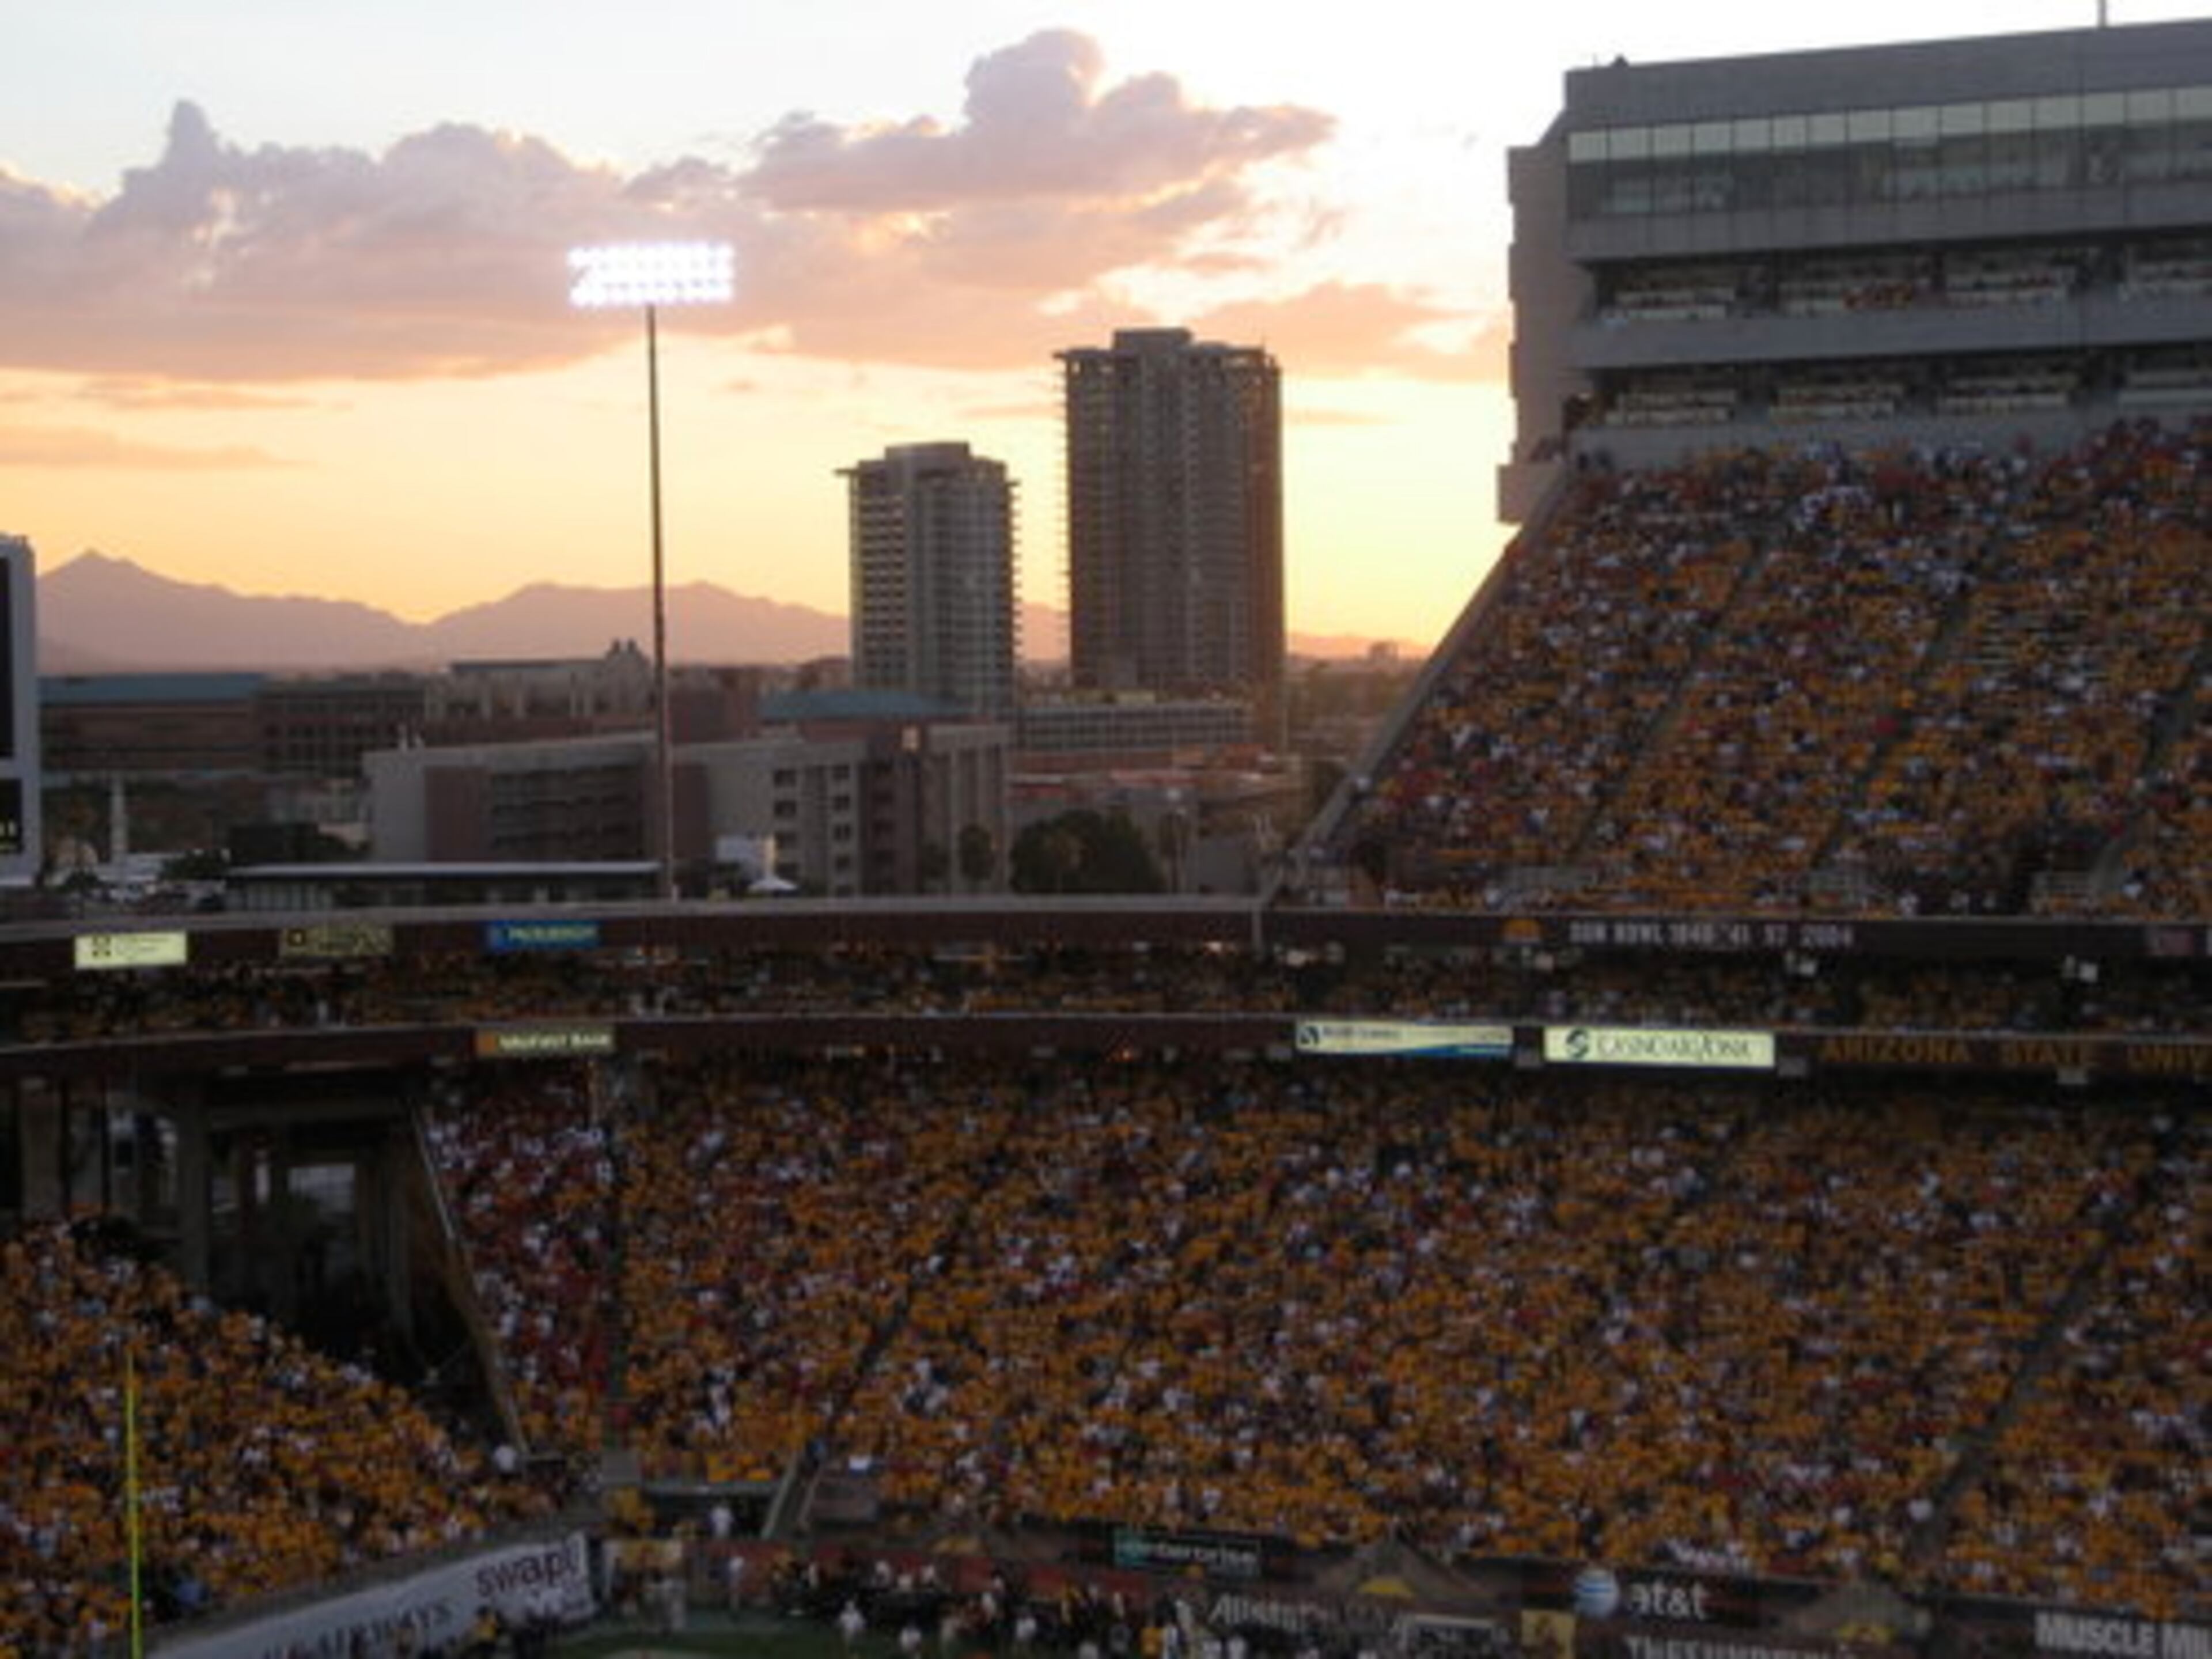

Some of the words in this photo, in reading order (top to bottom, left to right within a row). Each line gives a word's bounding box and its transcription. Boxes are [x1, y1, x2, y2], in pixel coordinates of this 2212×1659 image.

[1823, 1037, 1972, 1063] ARIZONA
[1999, 1040, 2100, 1068] STATE
[1630, 1578, 1715, 1621] at&t
[2034, 1611, 2154, 1656] MUSCLE
